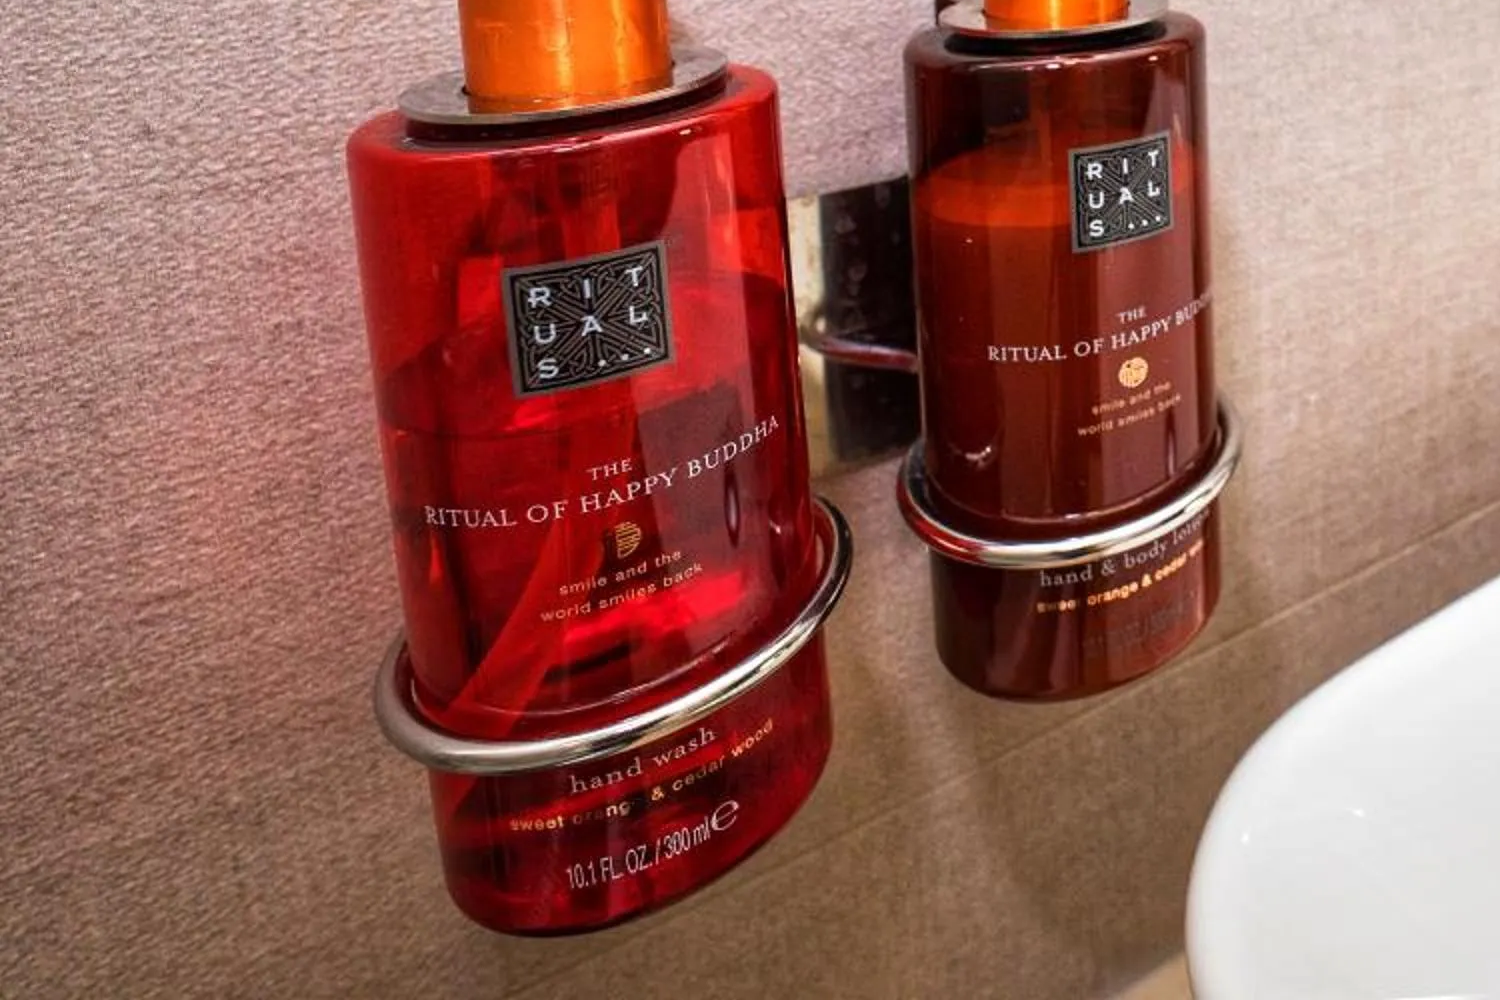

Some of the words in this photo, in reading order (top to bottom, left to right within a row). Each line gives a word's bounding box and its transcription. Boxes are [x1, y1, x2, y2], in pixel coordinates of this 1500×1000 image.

[1116, 305, 1147, 324] THE
[988, 345, 1067, 362] RITUAL
[1073, 337, 1105, 357] OF
[1111, 315, 1172, 349] HAPPY
[1077, 420, 1113, 436] world
[424, 504, 519, 528] RITUAL
[526, 499, 569, 523] OF
[579, 467, 678, 514] HAPPY
[687, 415, 779, 478] BUDDHA
[586, 457, 633, 481] THE
[558, 575, 608, 597] smile
[615, 561, 648, 584] and
[654, 549, 682, 569] the
[1040, 563, 1093, 588] hand
[1100, 558, 1117, 577] &
[1123, 539, 1167, 570] body
[540, 601, 592, 623] world
[598, 581, 657, 610] smiles
[662, 562, 704, 588] back
[1086, 581, 1139, 606] orange
[508, 815, 565, 831] sweet
[650, 785, 665, 801] &
[671, 754, 725, 792] cedar
[730, 717, 774, 758] wood
[569, 755, 644, 795] hand
[652, 727, 717, 767] wash
[565, 860, 598, 890] 10.1
